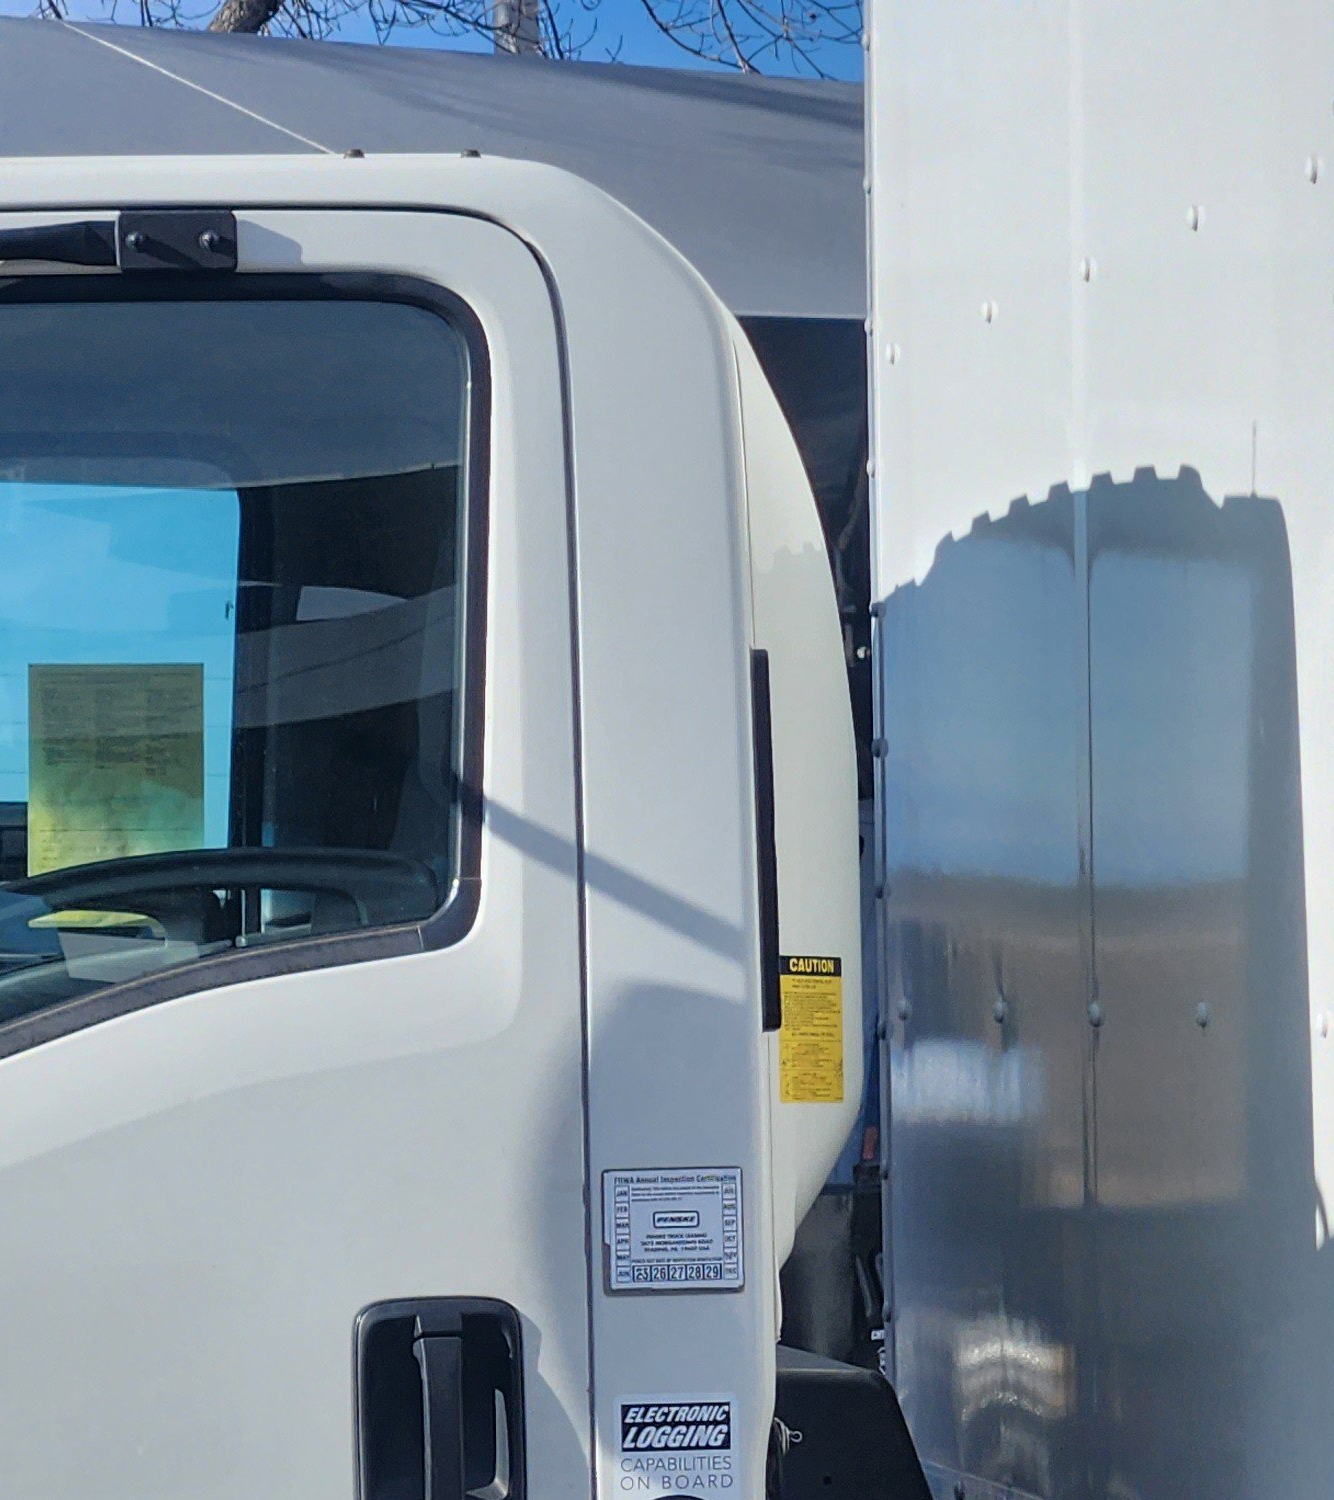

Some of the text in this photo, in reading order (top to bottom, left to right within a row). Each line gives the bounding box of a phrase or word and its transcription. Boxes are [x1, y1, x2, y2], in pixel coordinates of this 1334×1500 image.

[789, 958, 834, 973] CAUTION
[660, 1175, 695, 1183] Inspection
[653, 1267, 666, 1280] 26
[671, 1266, 684, 1279] 27
[688, 1266, 702, 1279] 28
[706, 1265, 719, 1278] 29
[624, 1405, 730, 1424] ELECTRONIC
[622, 1424, 729, 1449] LOGGING
[620, 1455, 732, 1473] CAPABILITIES
[620, 1474, 734, 1491] ON BOARD
